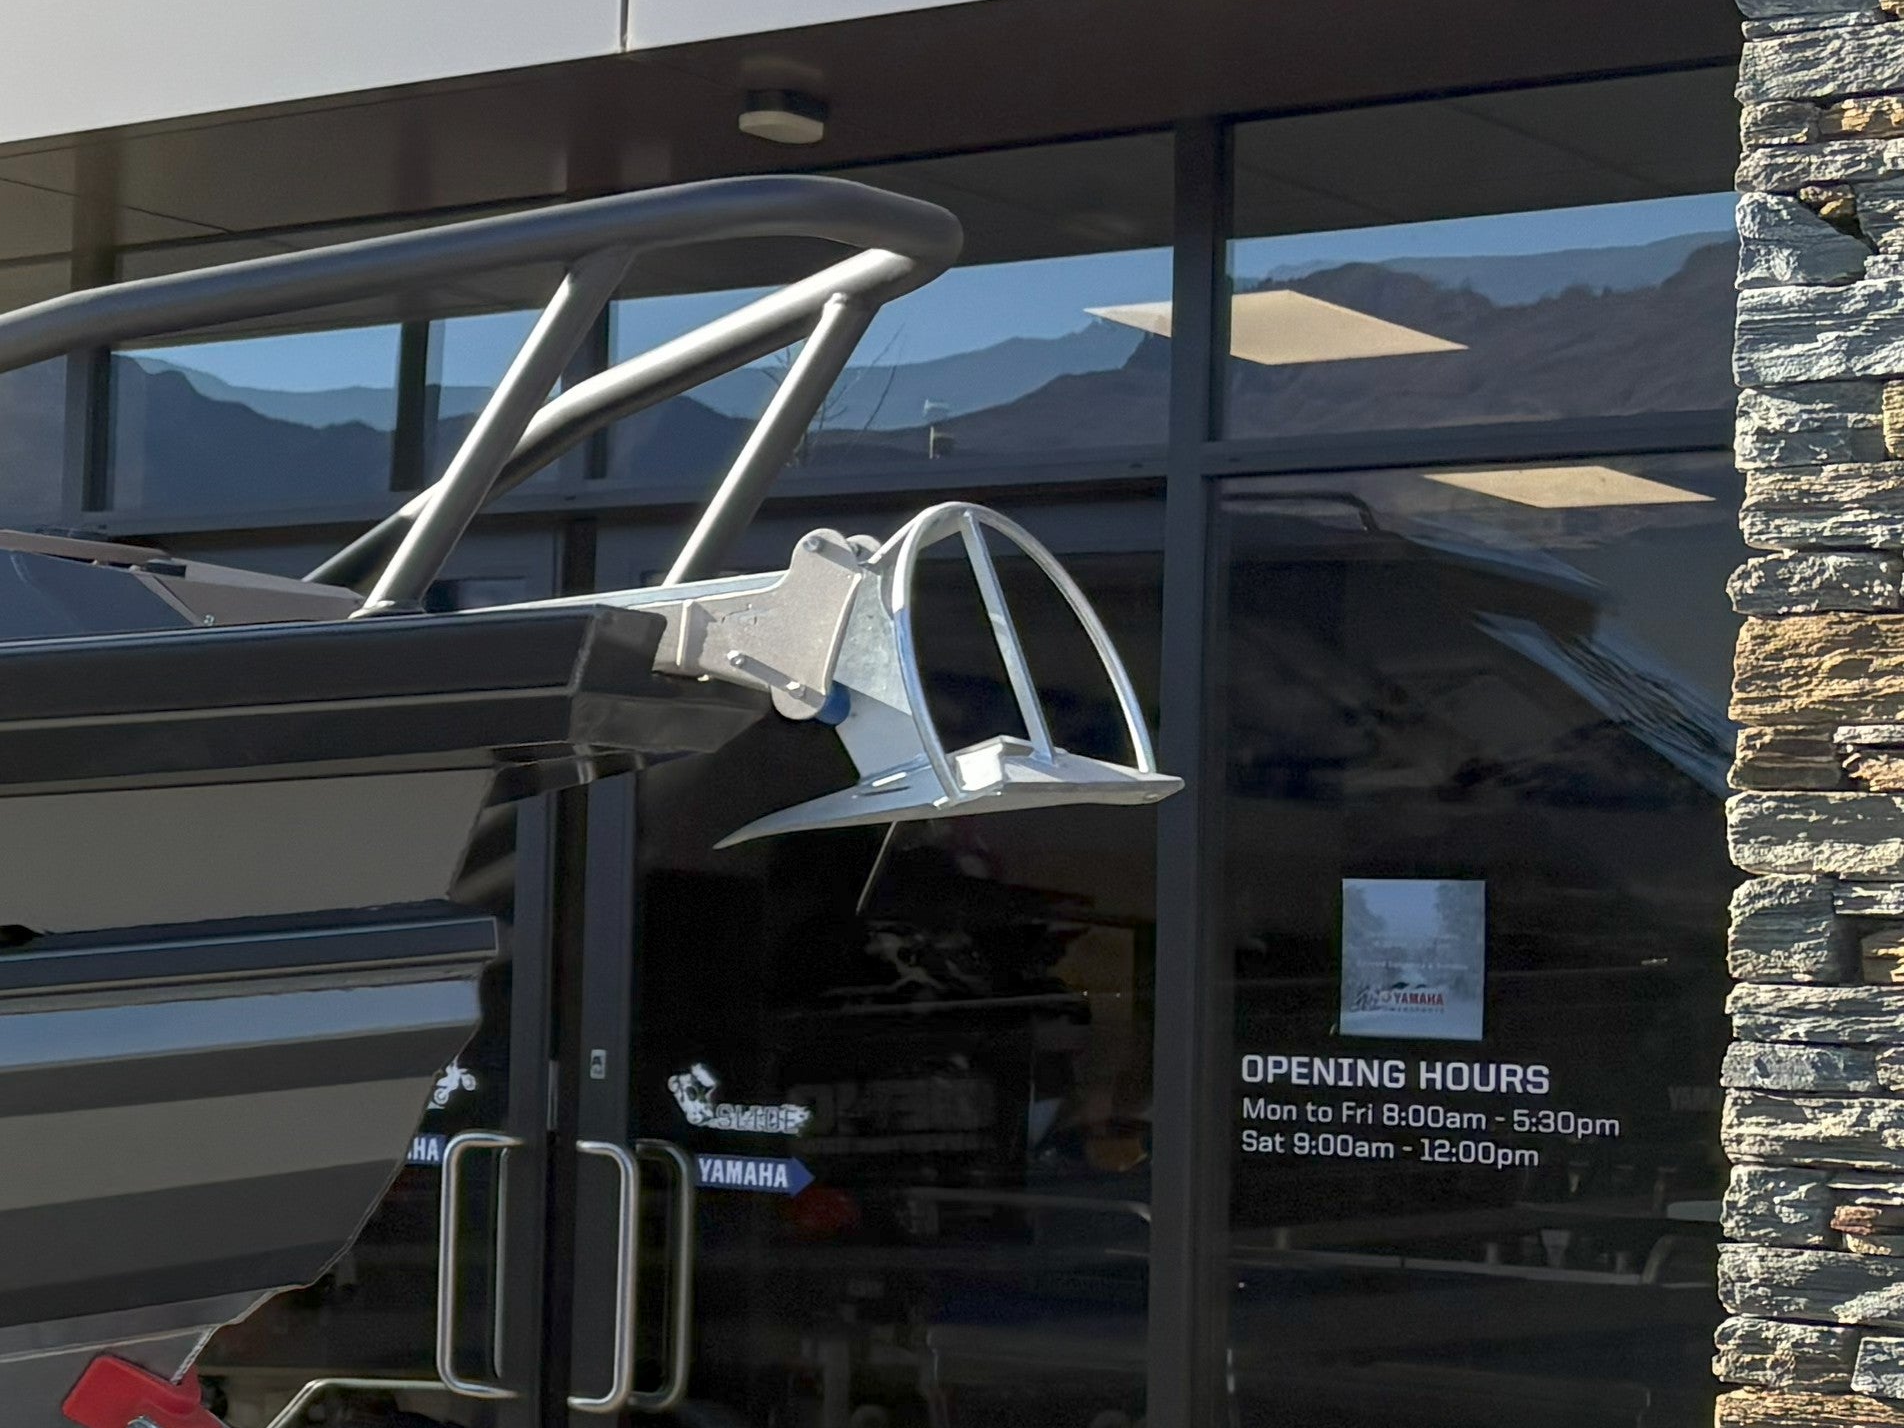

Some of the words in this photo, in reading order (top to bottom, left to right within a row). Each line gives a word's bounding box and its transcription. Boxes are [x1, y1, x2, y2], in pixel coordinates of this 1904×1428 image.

[1394, 992, 1445, 1006] YAMAHA
[1241, 1055, 1406, 1090] OPENING
[1419, 1062, 1550, 1094] HOURS
[716, 1103, 800, 1134] SLIDE
[1242, 1098, 1297, 1123] Mon
[1306, 1103, 1333, 1124] to
[1342, 1102, 1374, 1126] Fri
[1382, 1104, 1487, 1131] 8:00am
[1512, 1109, 1620, 1138] 5:30pm
[1242, 1130, 1285, 1154] Sat
[1293, 1133, 1394, 1159] 9:00am
[1419, 1139, 1539, 1168] 12:00pm
[698, 1157, 789, 1188] YAMAHA
